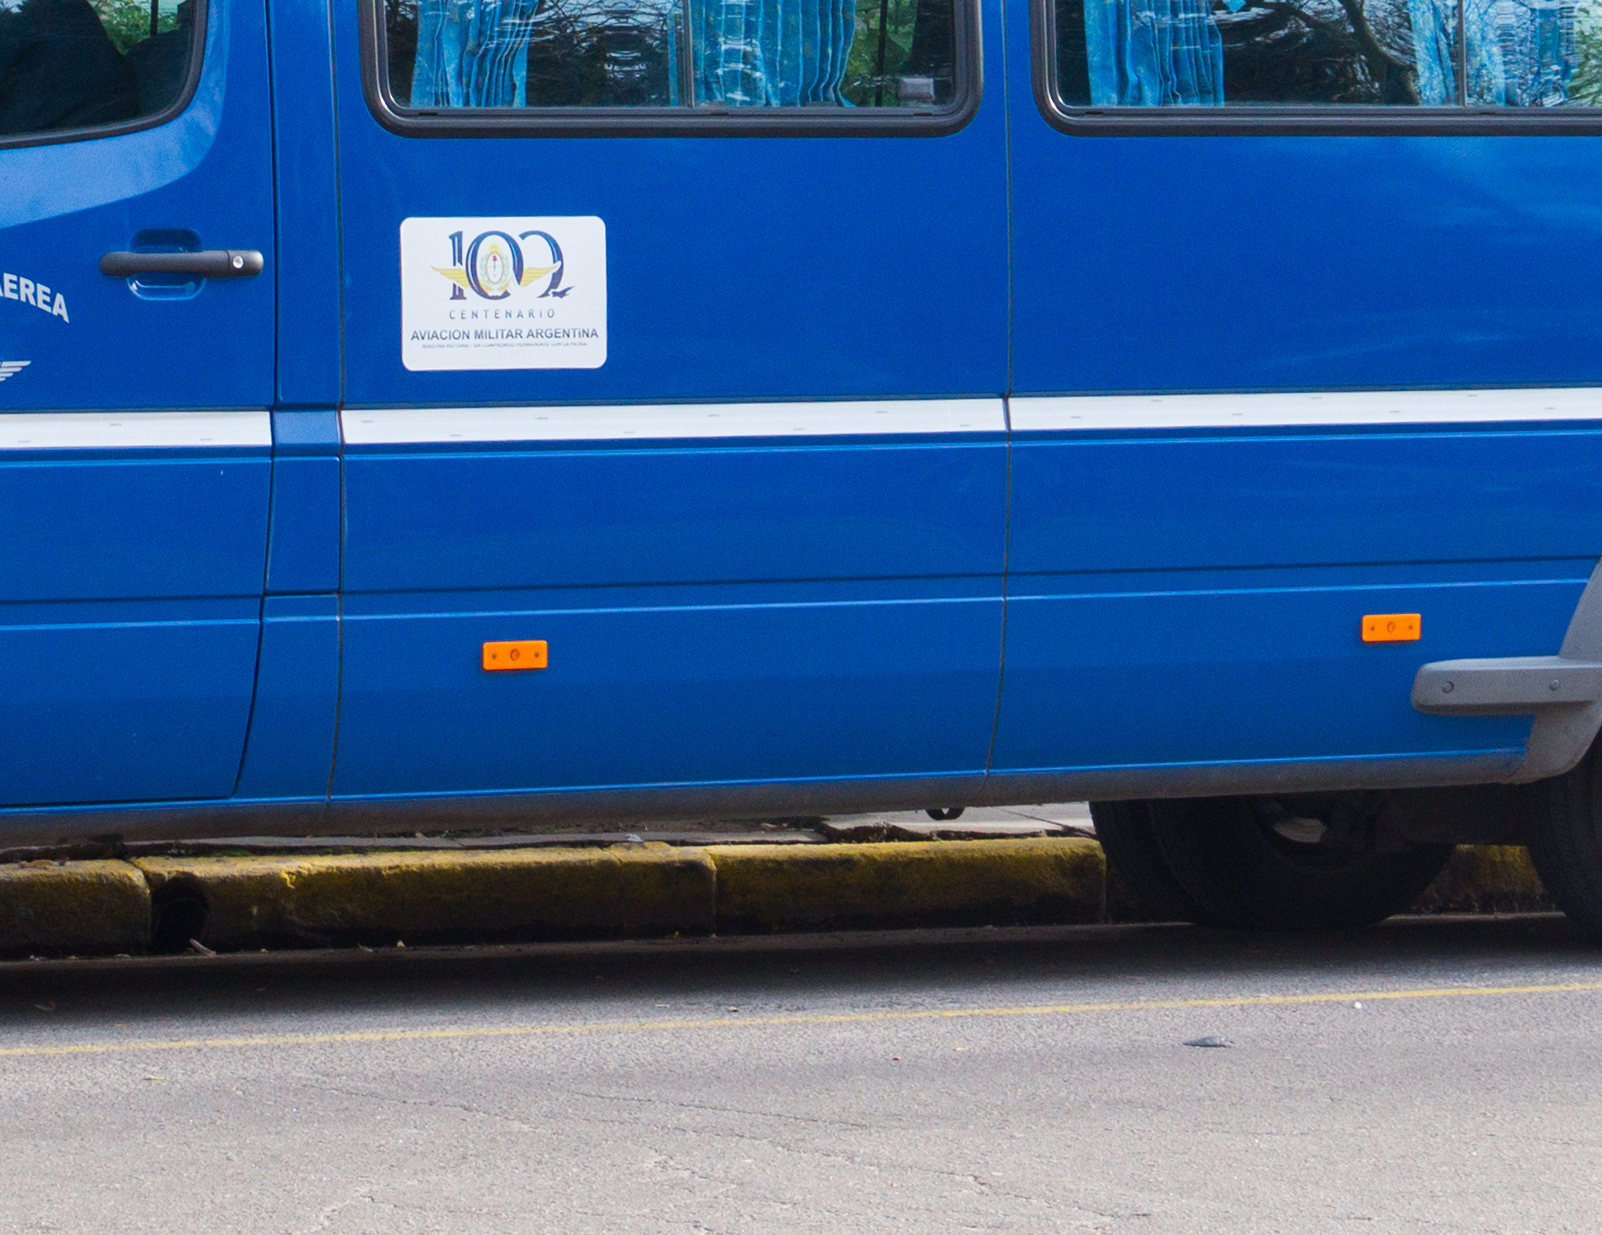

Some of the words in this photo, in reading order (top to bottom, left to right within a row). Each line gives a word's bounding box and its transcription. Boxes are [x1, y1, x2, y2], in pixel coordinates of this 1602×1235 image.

[449, 308, 555, 320] CENTENARIO
[474, 328, 523, 340] MILITAR
[526, 327, 599, 339] ARGENTINA
